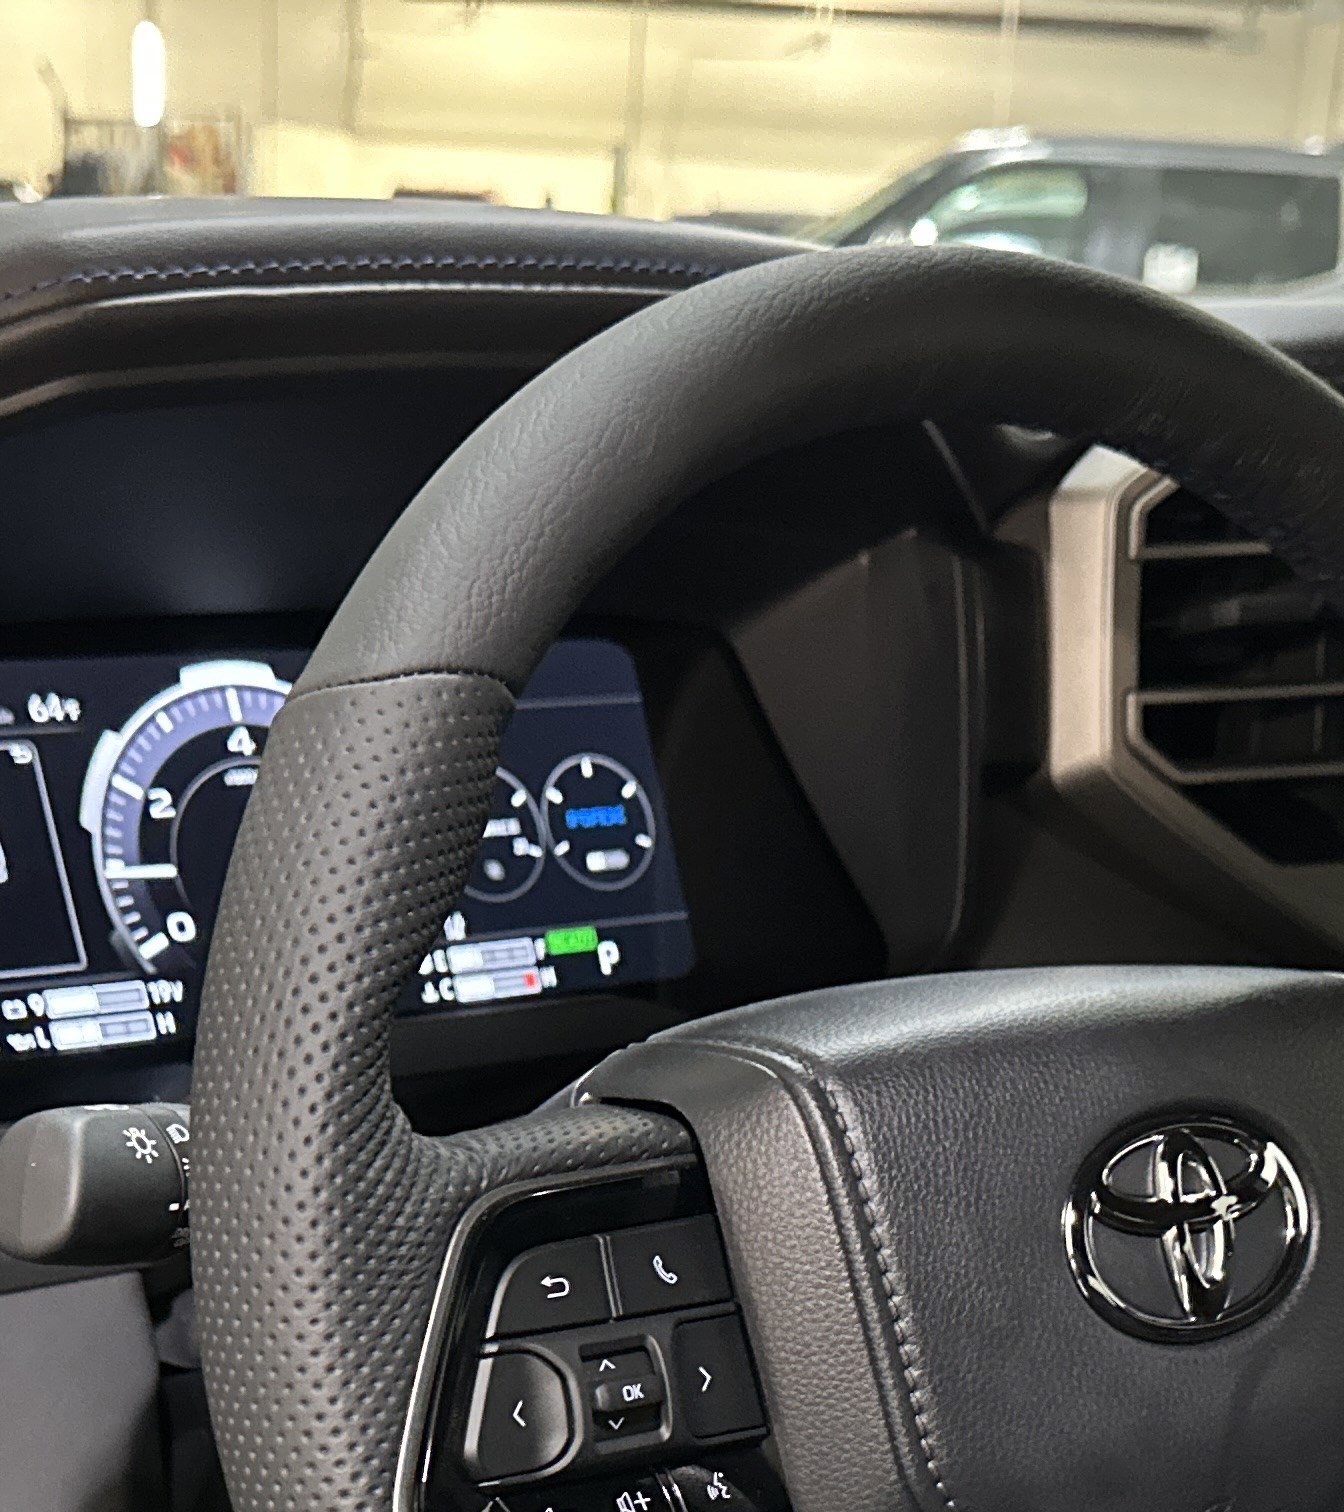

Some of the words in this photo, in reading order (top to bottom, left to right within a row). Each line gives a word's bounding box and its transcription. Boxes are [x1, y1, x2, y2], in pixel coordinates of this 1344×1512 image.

[226, 726, 256, 756] 4
[147, 788, 176, 819] 2
[166, 911, 196, 942] 0
[622, 1383, 645, 1403] OK
